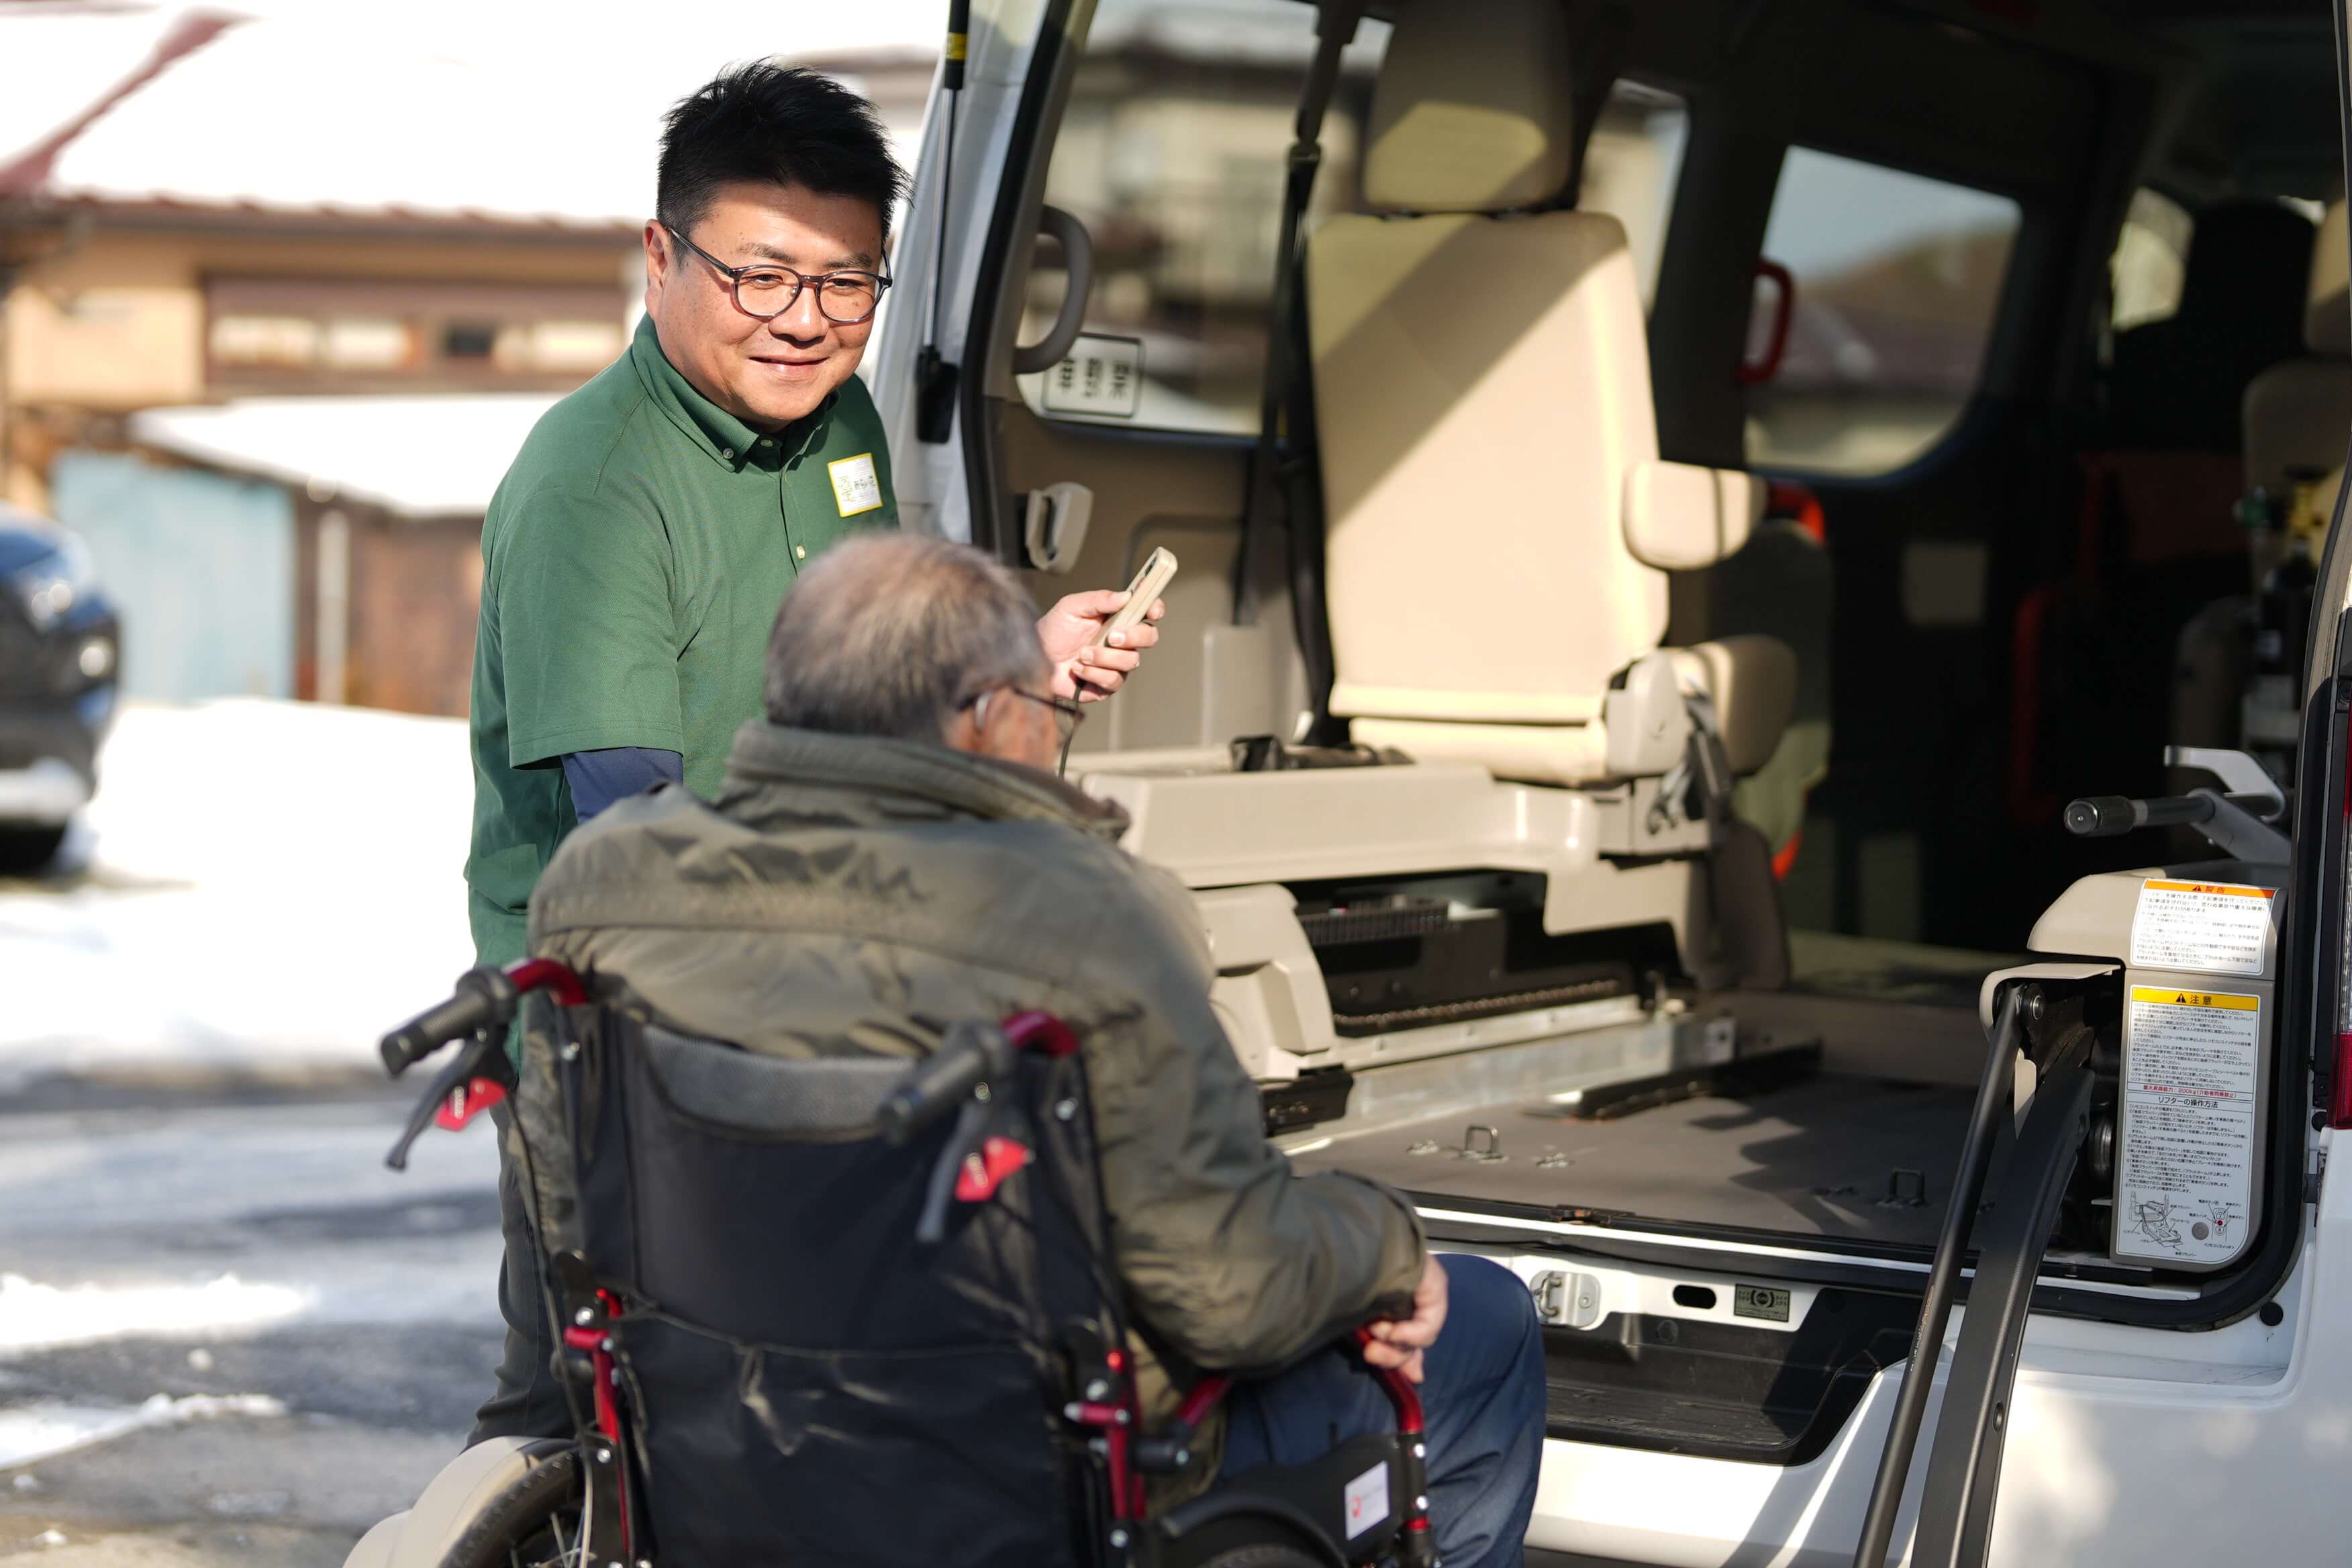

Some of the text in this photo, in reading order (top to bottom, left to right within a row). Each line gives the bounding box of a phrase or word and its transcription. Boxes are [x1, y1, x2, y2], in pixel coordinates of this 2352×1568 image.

[2190, 995, 2212, 1005] 注意
[2158, 1096, 2218, 1108] リフターの操作方法
